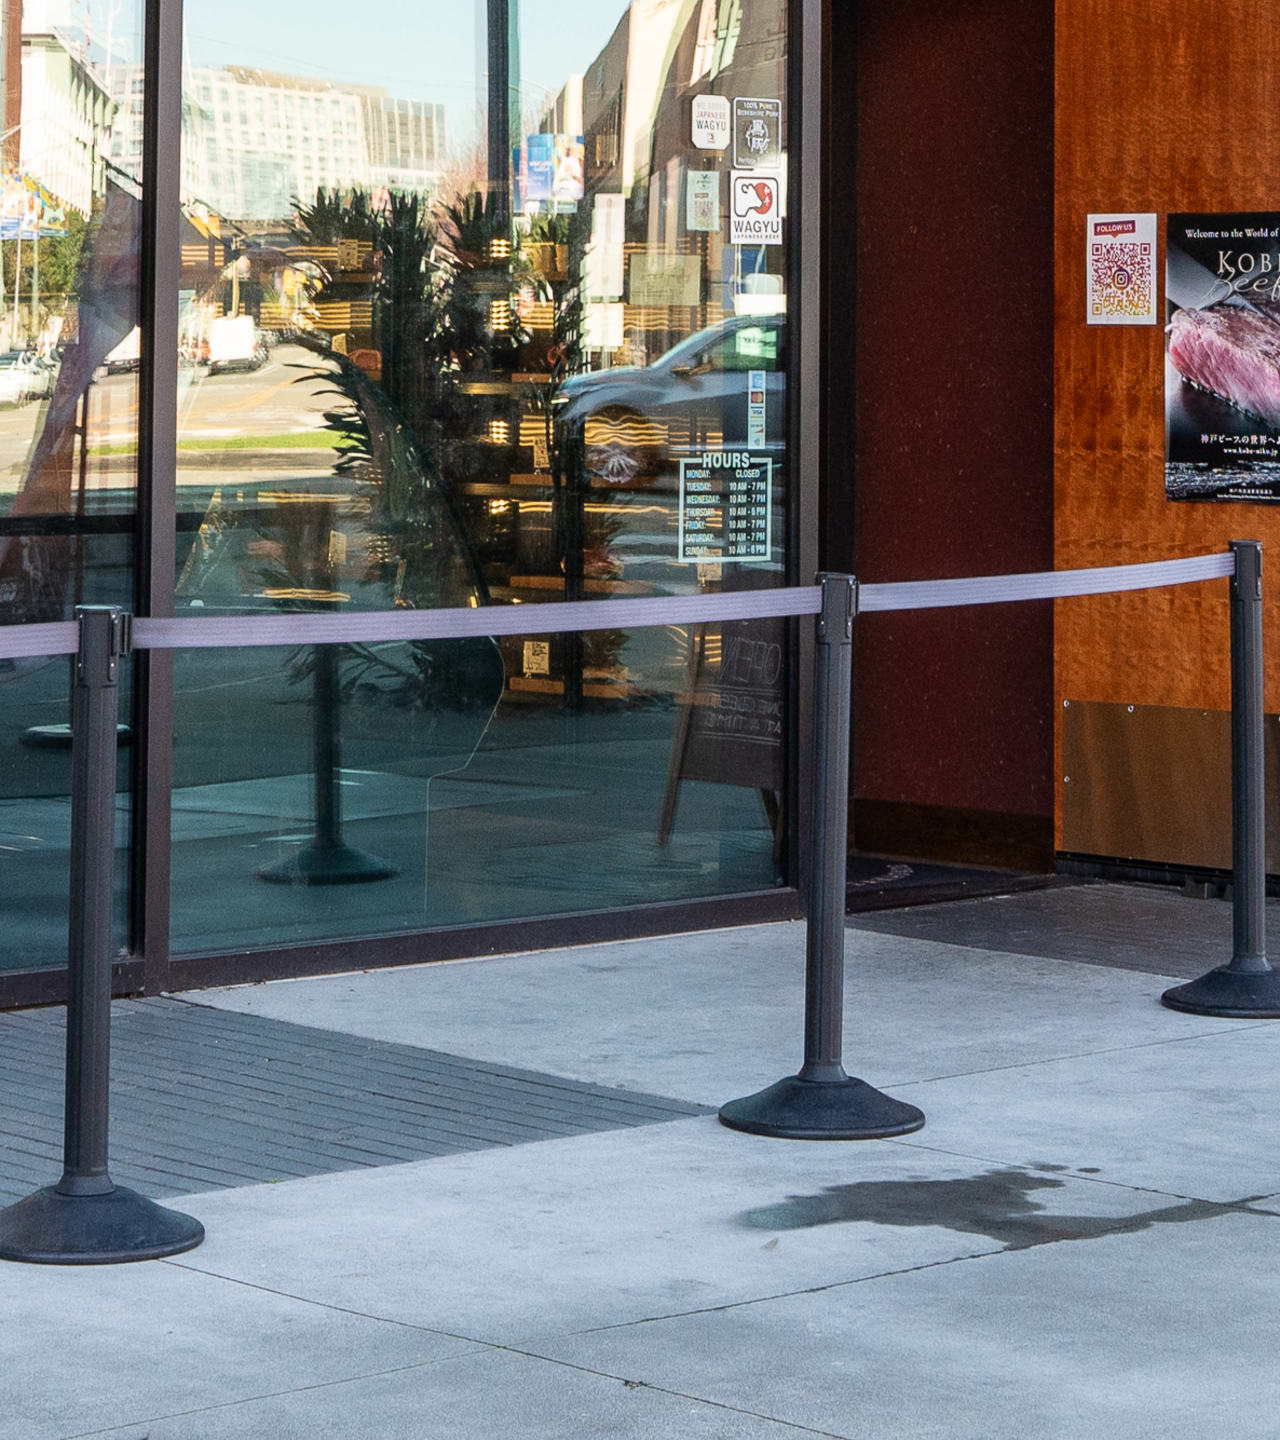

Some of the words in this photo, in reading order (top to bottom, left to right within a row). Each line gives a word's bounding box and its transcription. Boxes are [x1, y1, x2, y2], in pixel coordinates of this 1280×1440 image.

[696, 120, 727, 131] WAGYU
[733, 220, 780, 233] WAGYU
[1096, 223, 1123, 233] FOLLOW
[1123, 223, 1132, 231] US
[1185, 228, 1219, 239] Welcome
[1221, 230, 1229, 238] to
[1231, 228, 1243, 238] the
[1245, 228, 1268, 238] World
[1270, 227, 1280, 237] of
[702, 452, 750, 468] HOURS
[736, 469, 760, 478] CLOSED
[729, 482, 737, 491] 10
[737, 482, 747, 491] AM
[751, 482, 756, 491] 7
[756, 482, 766, 491] PM
[729, 494, 737, 504] 10
[737, 494, 747, 504] AM
[751, 494, 756, 504] 7
[756, 494, 766, 504] PM
[729, 507, 737, 516] 10
[737, 507, 747, 516] AM
[756, 507, 766, 516] PM
[729, 520, 737, 529] 10
[737, 520, 747, 529] AM
[751, 520, 756, 529] 7
[756, 520, 766, 529] PM
[728, 532, 737, 541] 10
[737, 532, 747, 541] AM
[751, 532, 756, 541] 7
[756, 532, 766, 541] PM
[728, 545, 737, 554] 10
[737, 545, 747, 554] AM
[756, 545, 766, 554] PM
